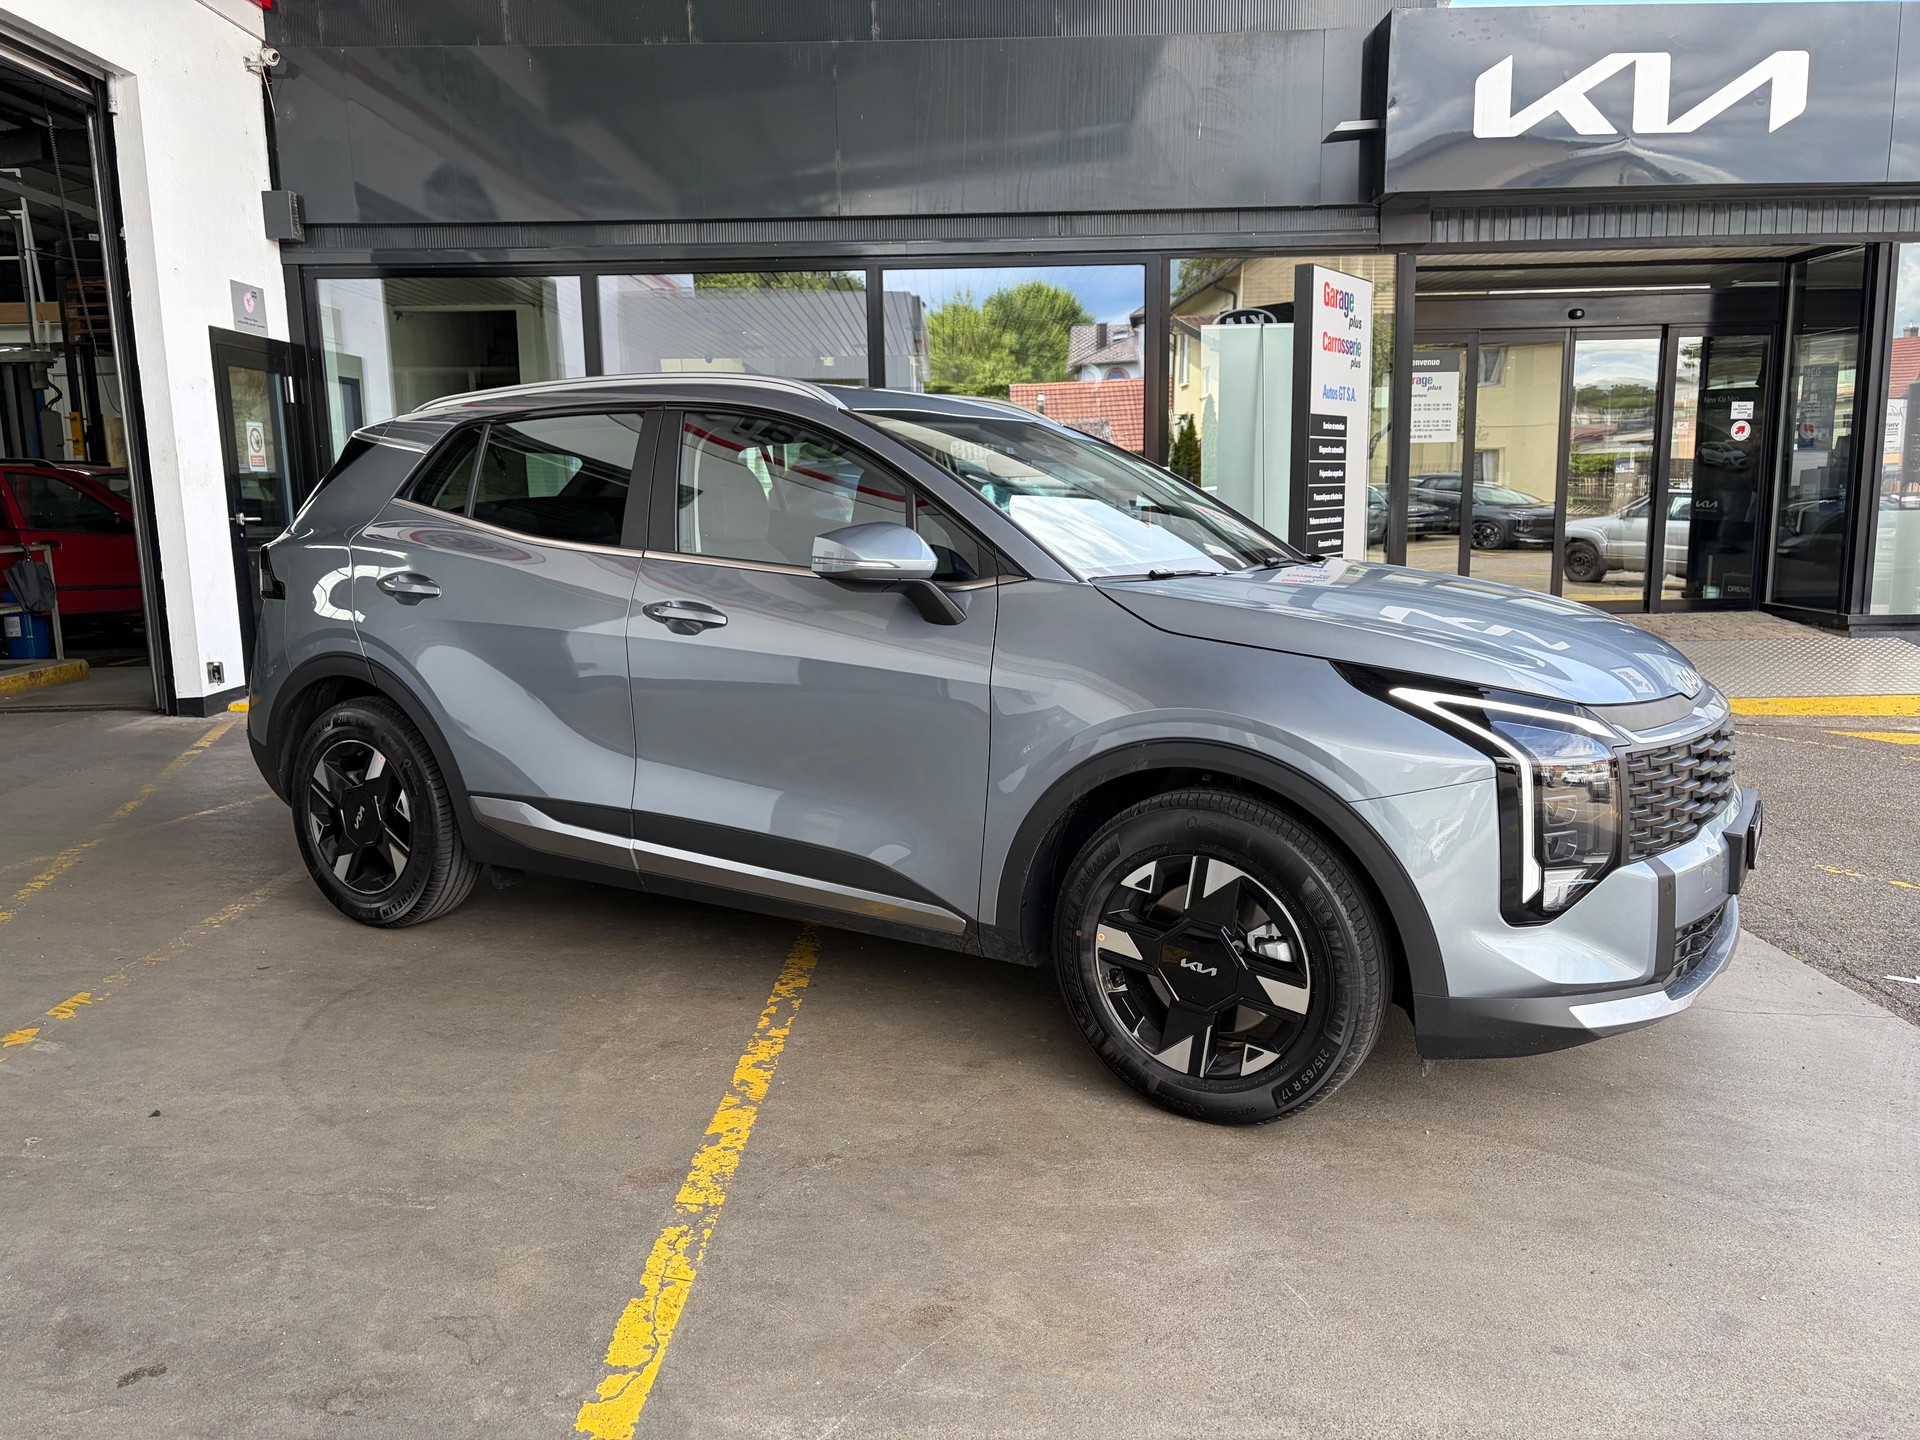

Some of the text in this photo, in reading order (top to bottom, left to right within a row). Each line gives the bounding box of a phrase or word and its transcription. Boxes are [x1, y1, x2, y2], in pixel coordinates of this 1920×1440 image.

[1473, 50, 1810, 138] KIA
[1323, 281, 1355, 318] Garage
[1348, 315, 1362, 330] plus
[1322, 331, 1362, 357] Carrosserie
[1350, 359, 1361, 370] plus
[1412, 359, 1441, 367] envenue
[1411, 376, 1433, 388] rage
[1427, 384, 1442, 392] plus
[1322, 384, 1338, 401] Autos
[1338, 386, 1346, 401] GT
[382, 876, 420, 918] MICHELIN
[1180, 958, 1218, 977] KIA
[1301, 1048, 1330, 1085] 215/65
[1281, 1087, 1293, 1100] 17
[1292, 1080, 1302, 1091] R
